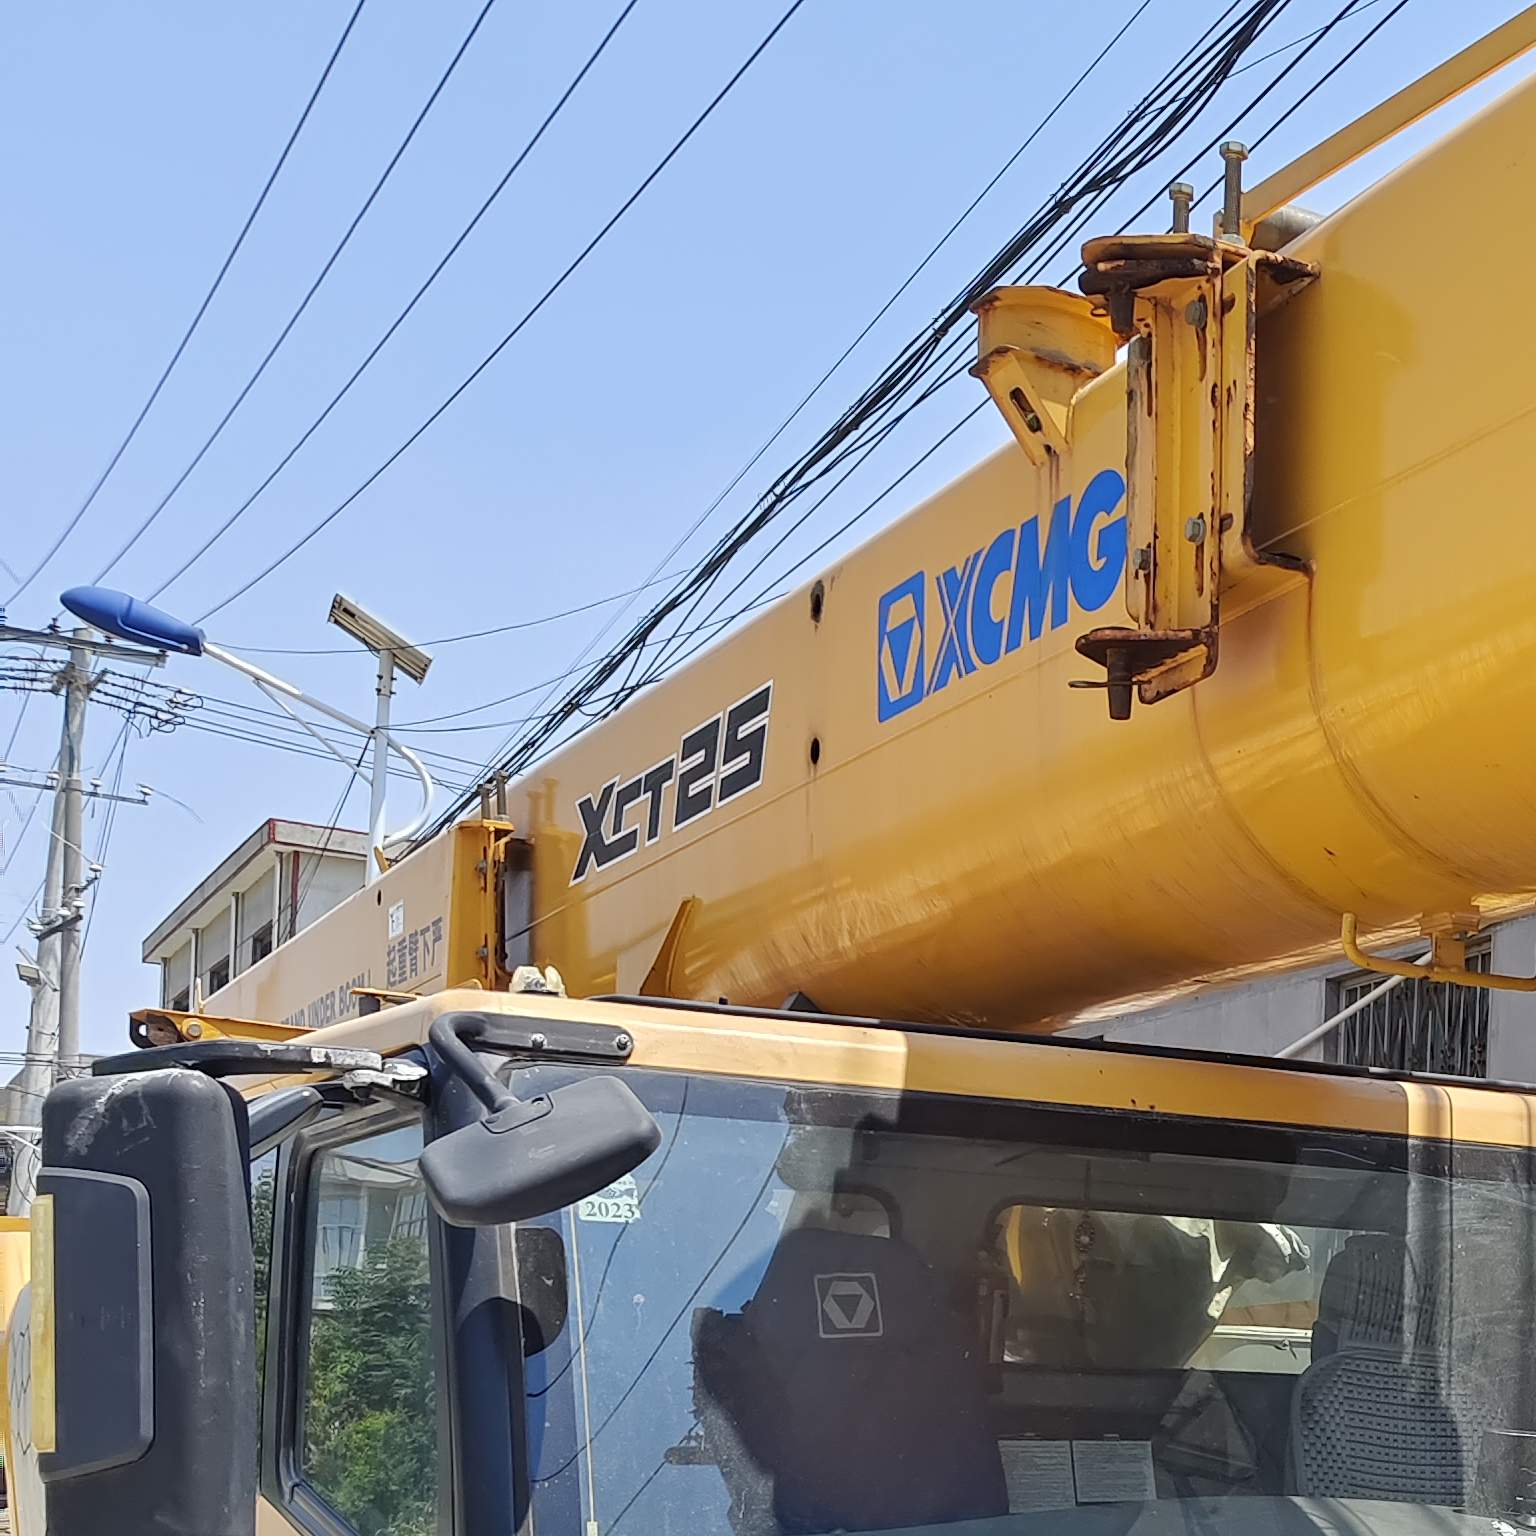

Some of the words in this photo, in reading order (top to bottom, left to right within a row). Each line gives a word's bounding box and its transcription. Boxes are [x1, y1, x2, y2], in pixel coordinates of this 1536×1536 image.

[923, 469, 1128, 698] XCMG
[569, 679, 773, 887] XCT25
[585, 1201, 635, 1219] 2023
